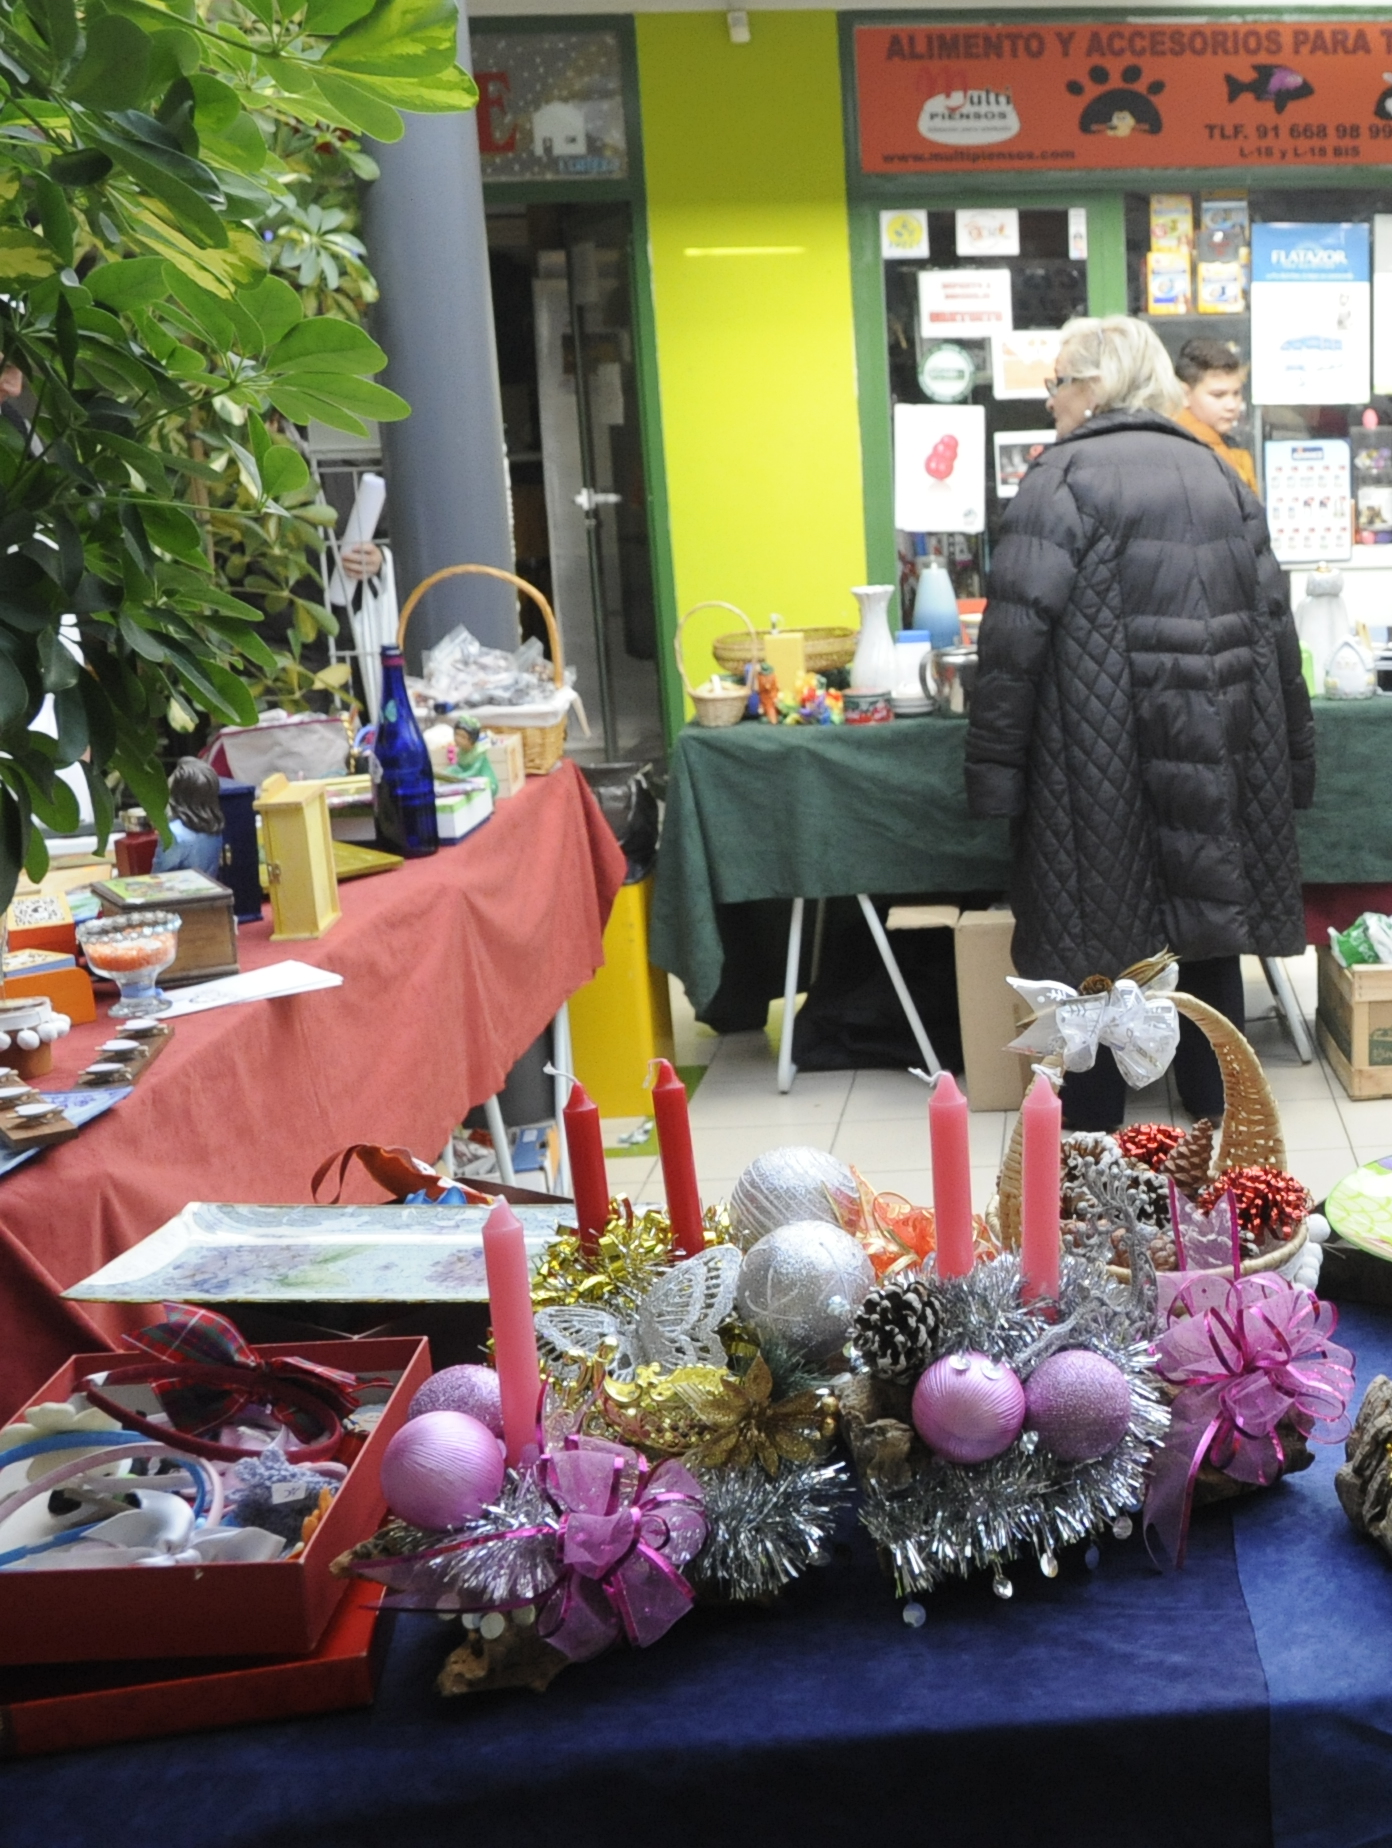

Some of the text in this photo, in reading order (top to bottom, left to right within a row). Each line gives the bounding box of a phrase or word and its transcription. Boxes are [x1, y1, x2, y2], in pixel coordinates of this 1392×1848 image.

[886, 32, 1046, 60] ALIMENTO
[1054, 31, 1076, 58] Y
[1086, 30, 1283, 58] ACCESORIOS
[1293, 29, 1371, 55] PARA
[929, 111, 1007, 121] PIENSOS
[1256, 123, 1280, 139] 91
[1289, 123, 1328, 139] 668
[1336, 123, 1361, 139] 98
[1270, 249, 1348, 265] FLATAZOR
